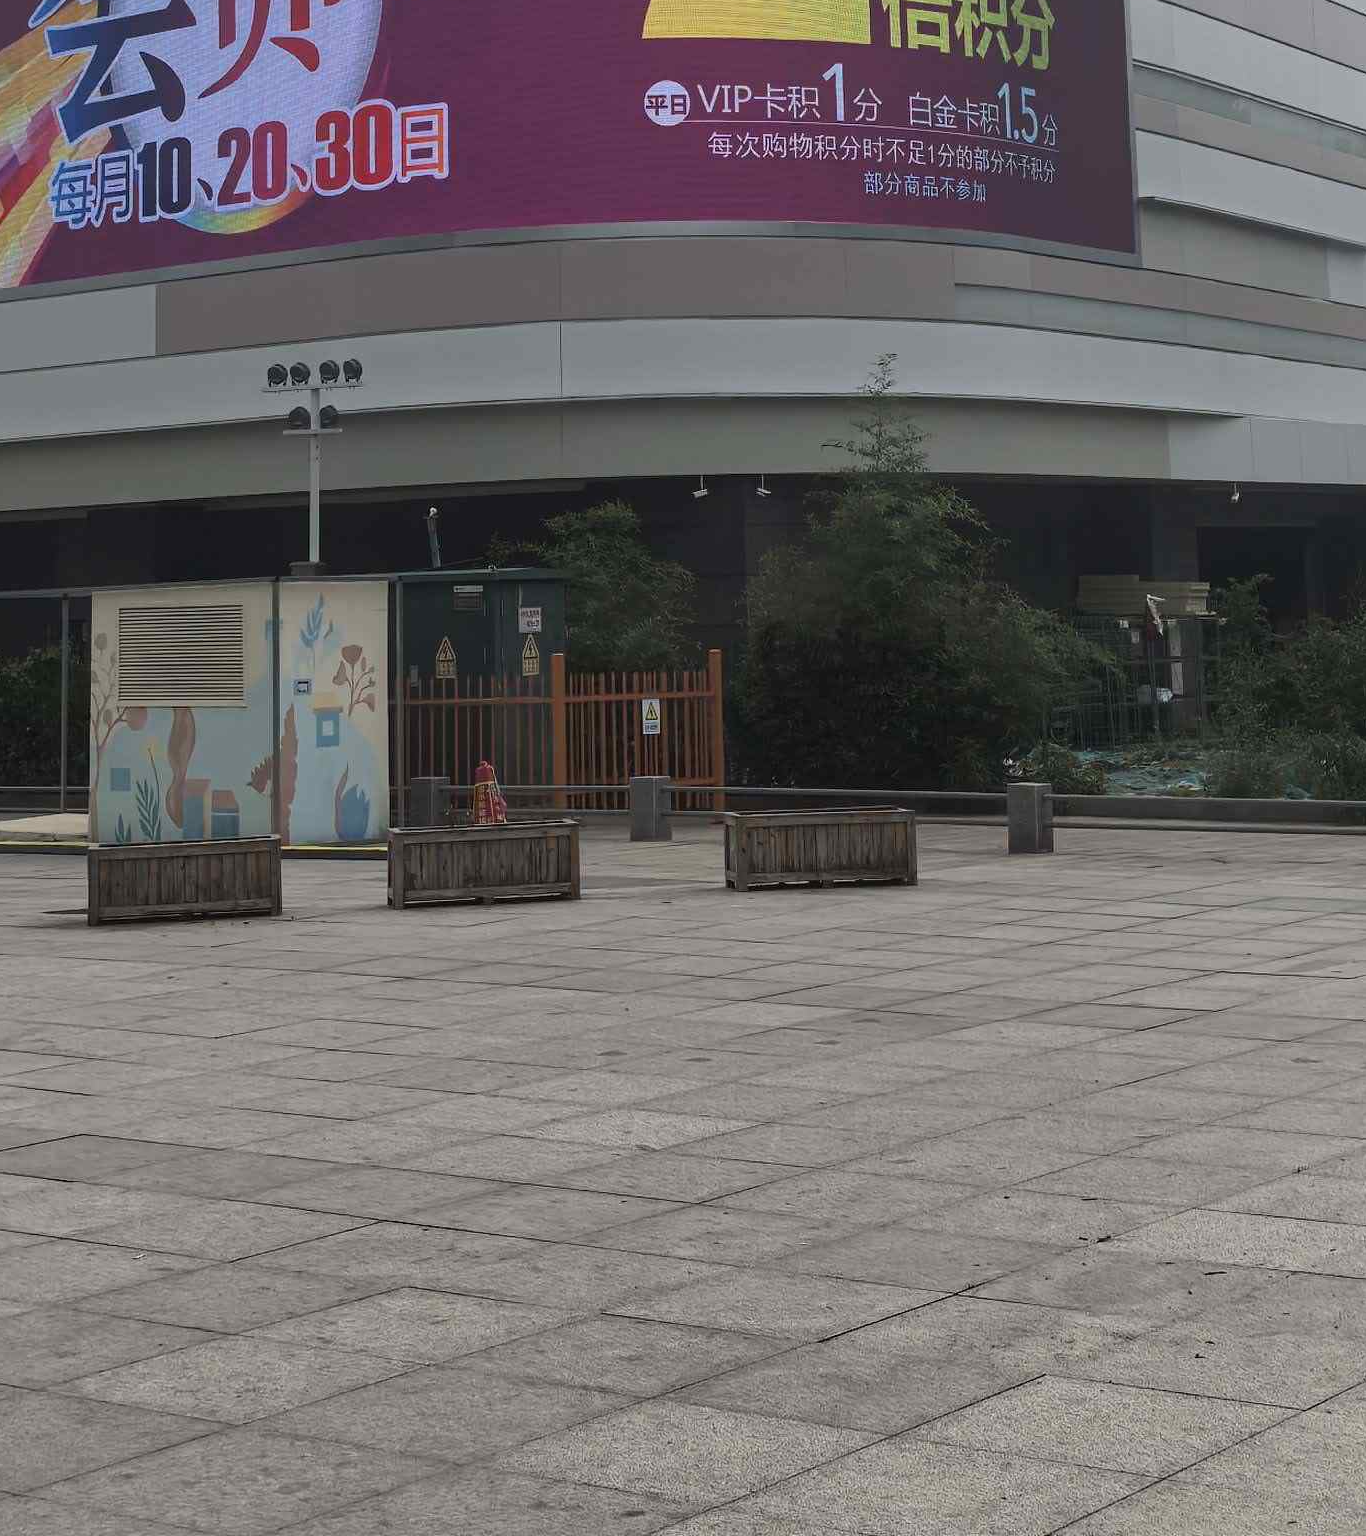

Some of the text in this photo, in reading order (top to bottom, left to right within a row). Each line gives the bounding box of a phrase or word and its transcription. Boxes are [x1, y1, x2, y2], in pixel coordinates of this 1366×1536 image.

[645, 94, 689, 117] 平日
[863, 170, 987, 202] 部分商品不参加
